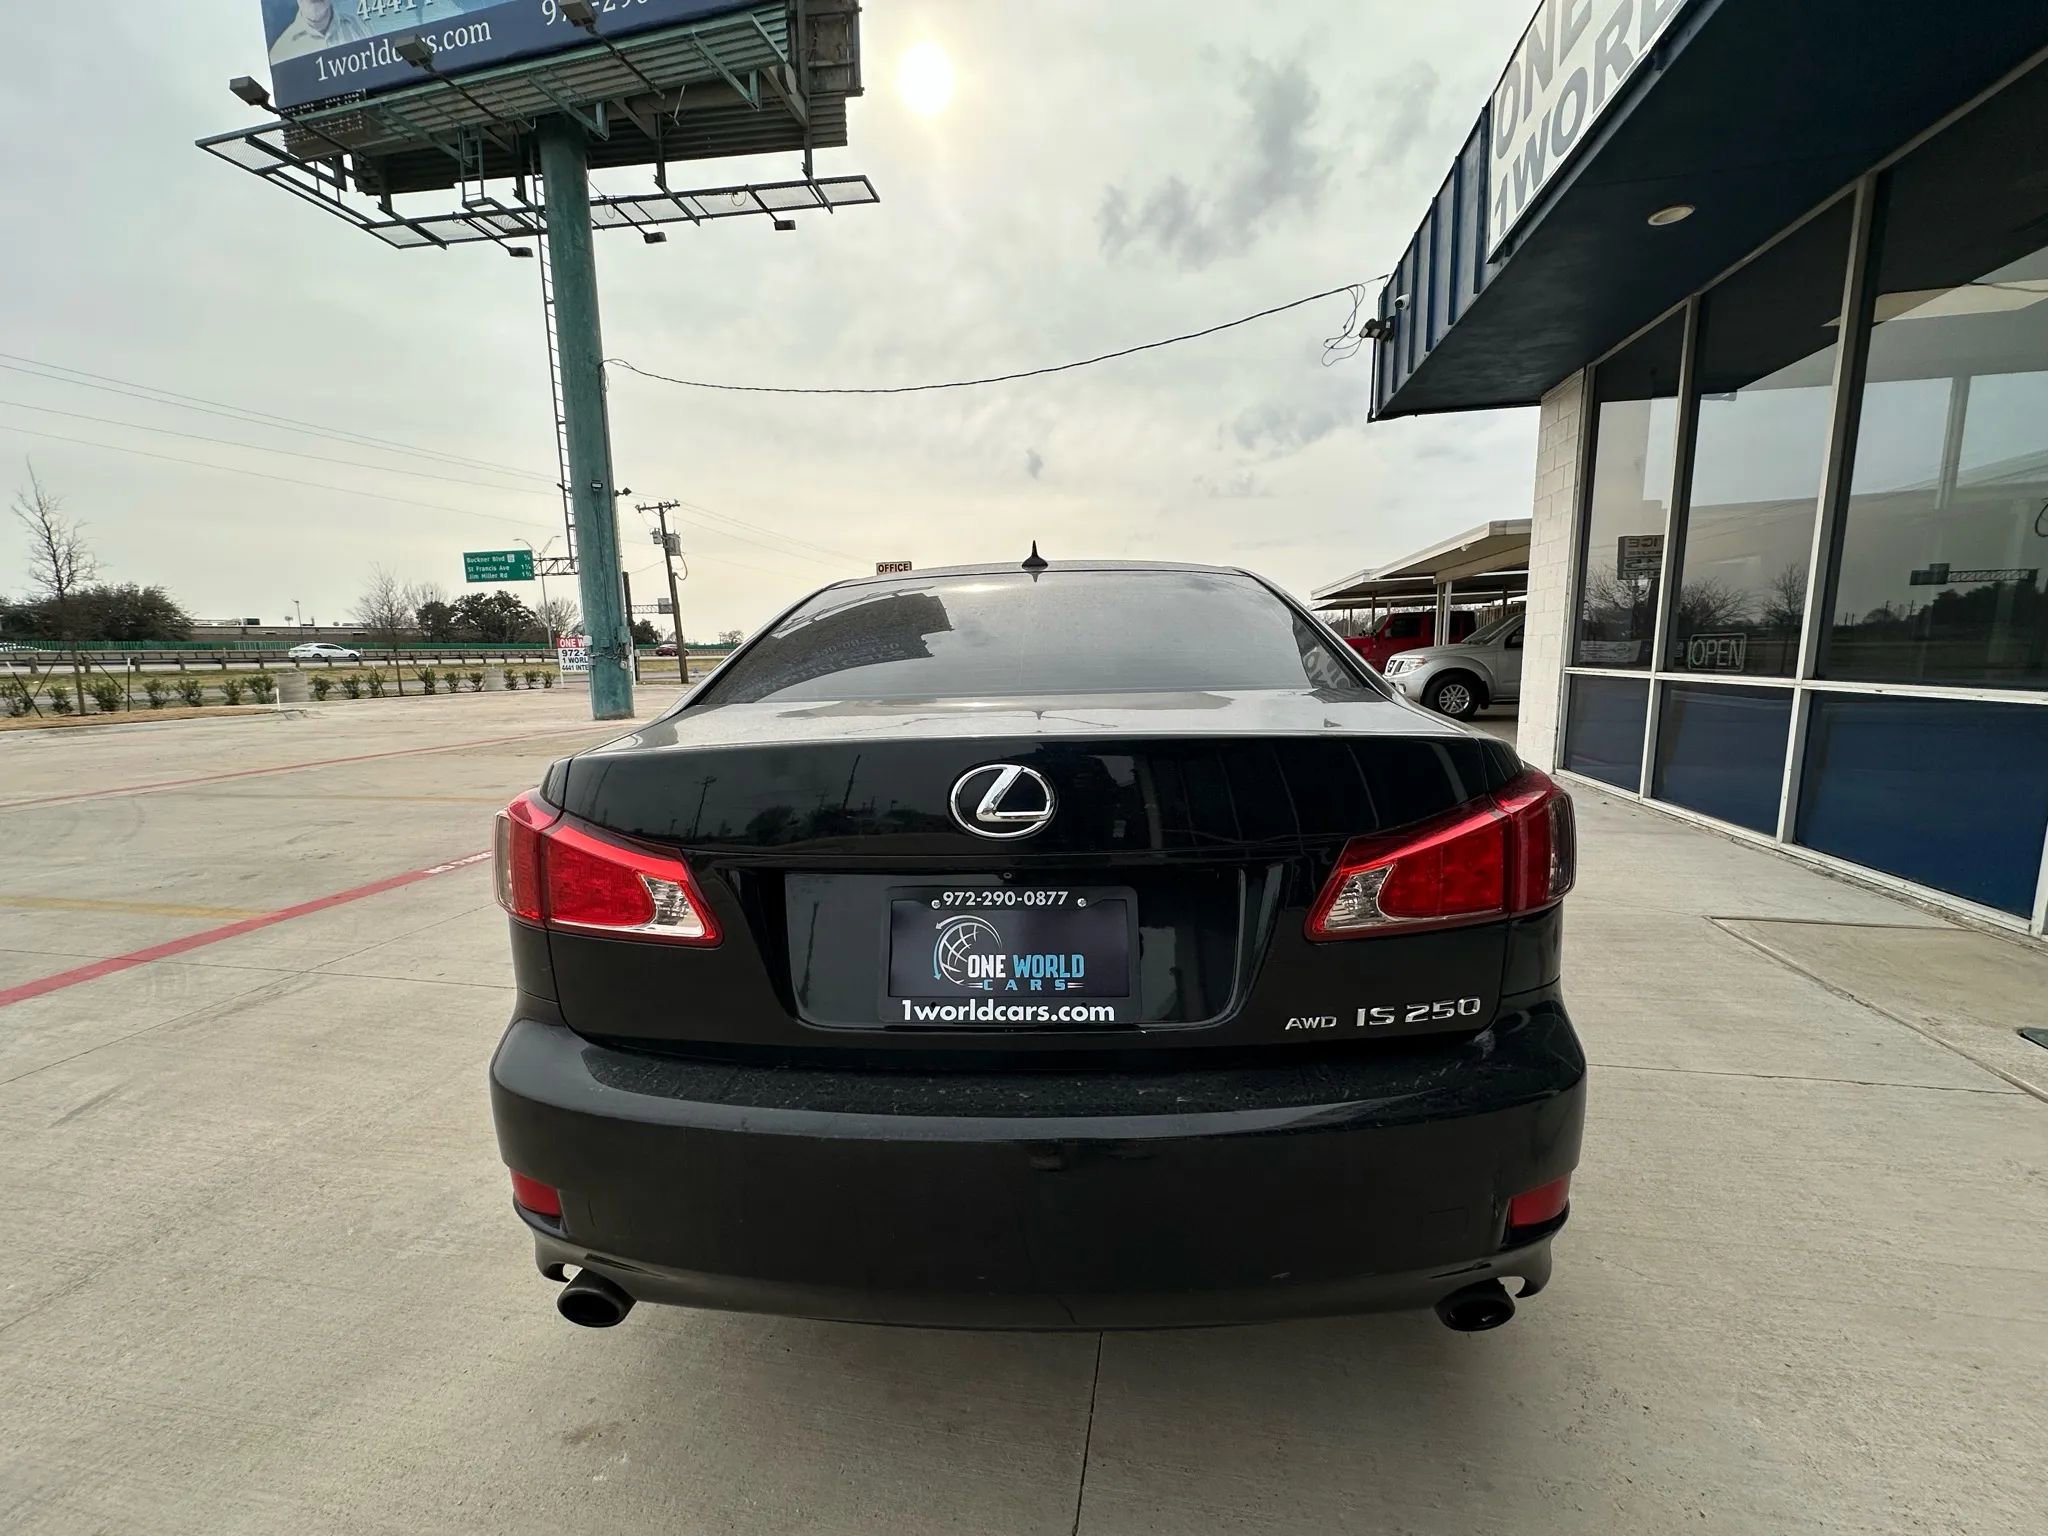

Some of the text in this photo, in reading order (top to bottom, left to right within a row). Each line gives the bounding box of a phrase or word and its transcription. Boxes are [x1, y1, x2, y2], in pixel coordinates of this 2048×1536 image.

[315, 21, 492, 82] 1worldcs.com
[878, 563, 909, 573] OFFICE
[559, 638, 577, 648] ONE
[1691, 639, 1743, 667] OPEN
[942, 891, 1069, 907] 972-290-0877
[967, 954, 1086, 978] ONE WORLD
[983, 979, 1067, 991] CARS
[902, 998, 1115, 1022] 1worldcars.com
[1285, 995, 1481, 1030] AWD IS 250
